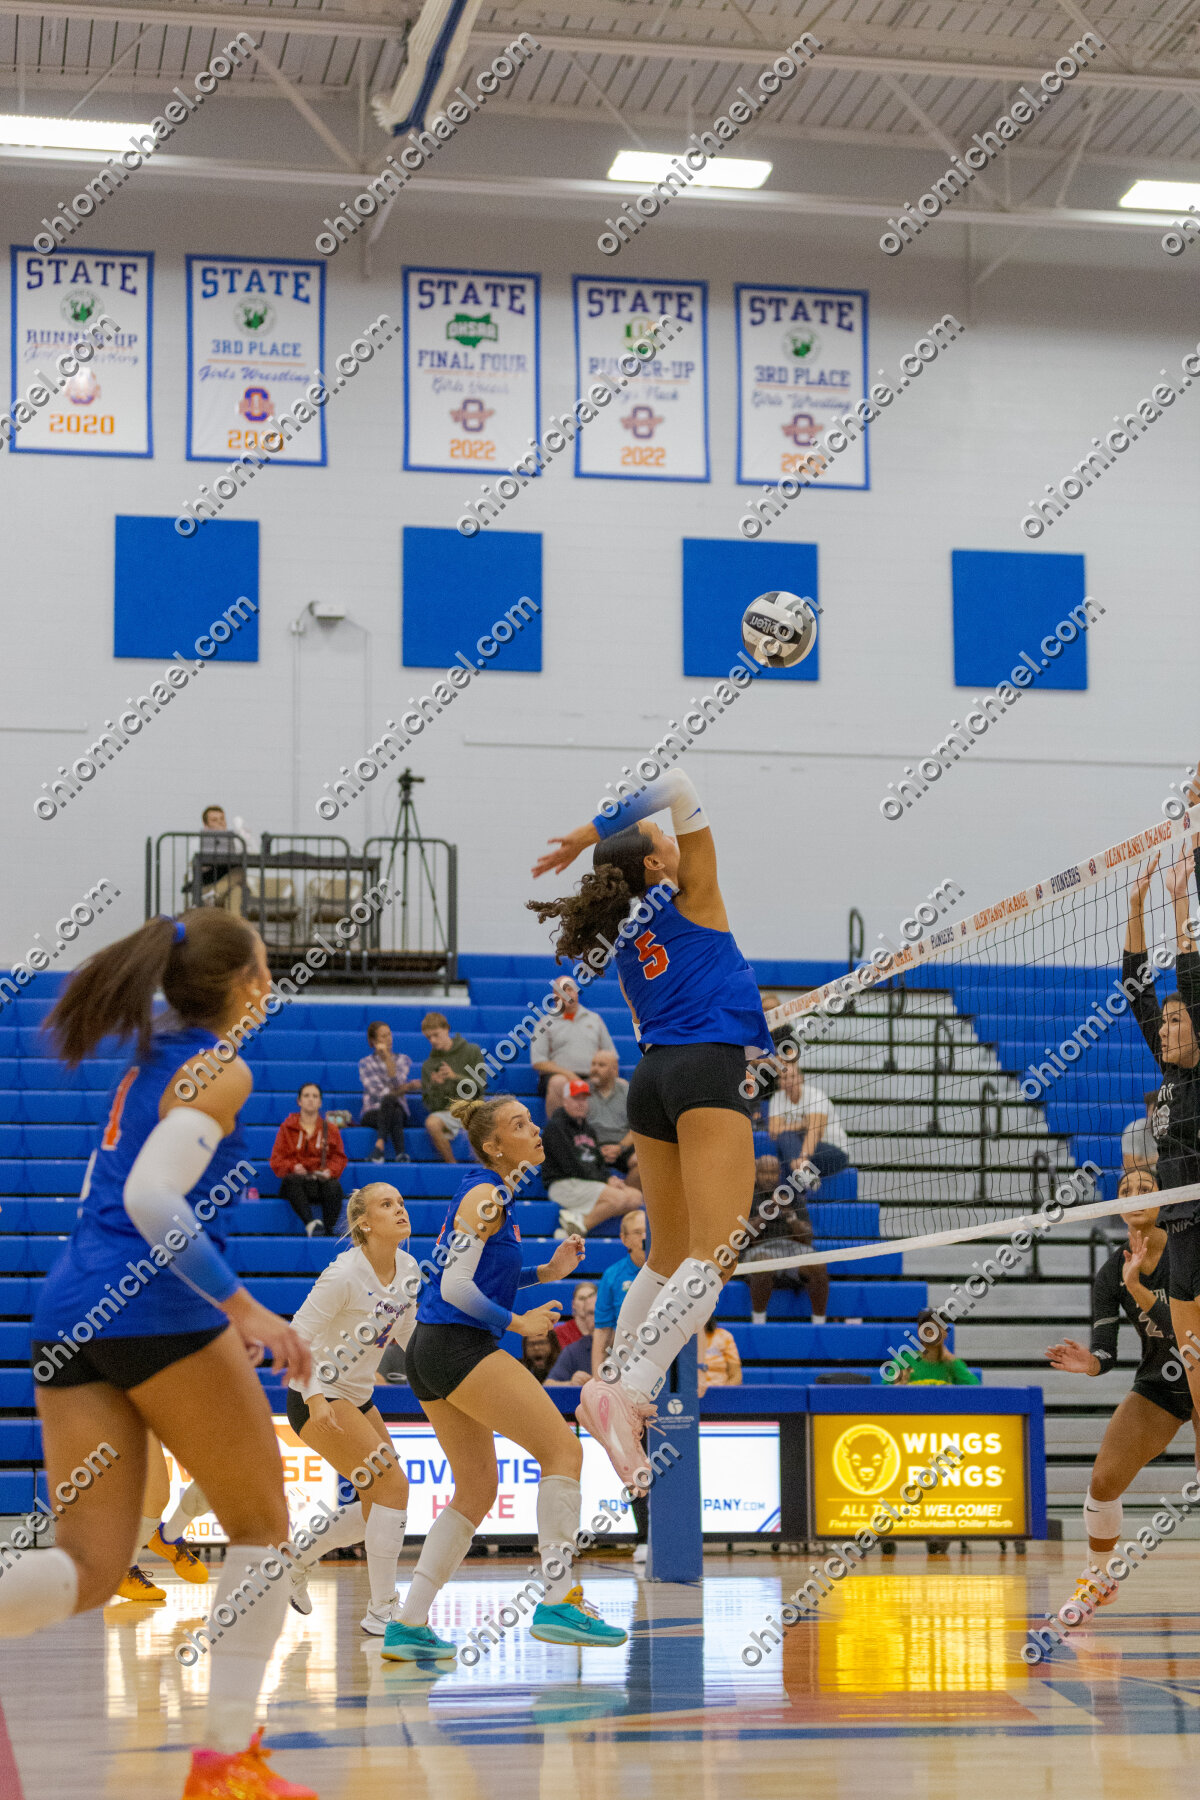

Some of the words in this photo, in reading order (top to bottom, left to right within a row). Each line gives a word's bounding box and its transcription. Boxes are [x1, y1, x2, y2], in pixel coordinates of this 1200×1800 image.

[27, 258, 138, 295] STATE
[201, 267, 311, 304] STATE
[418, 280, 525, 315] STATE
[587, 288, 693, 322] STATE
[749, 296, 854, 333] STATE
[211, 339, 243, 354] 3RD
[248, 341, 302, 357] PLACE
[418, 350, 474, 369] FINAL
[755, 365, 788, 384] 3RD
[793, 367, 850, 387] PLACE
[49, 413, 115, 435] 2020
[449, 439, 496, 461] 2022
[620, 446, 666, 467] 2022
[634, 929, 670, 980] 5
[902, 1432, 1002, 1455] WINGS
[840, 1504, 868, 1517] ALL
[924, 1504, 1003, 1517] WELCOME!
